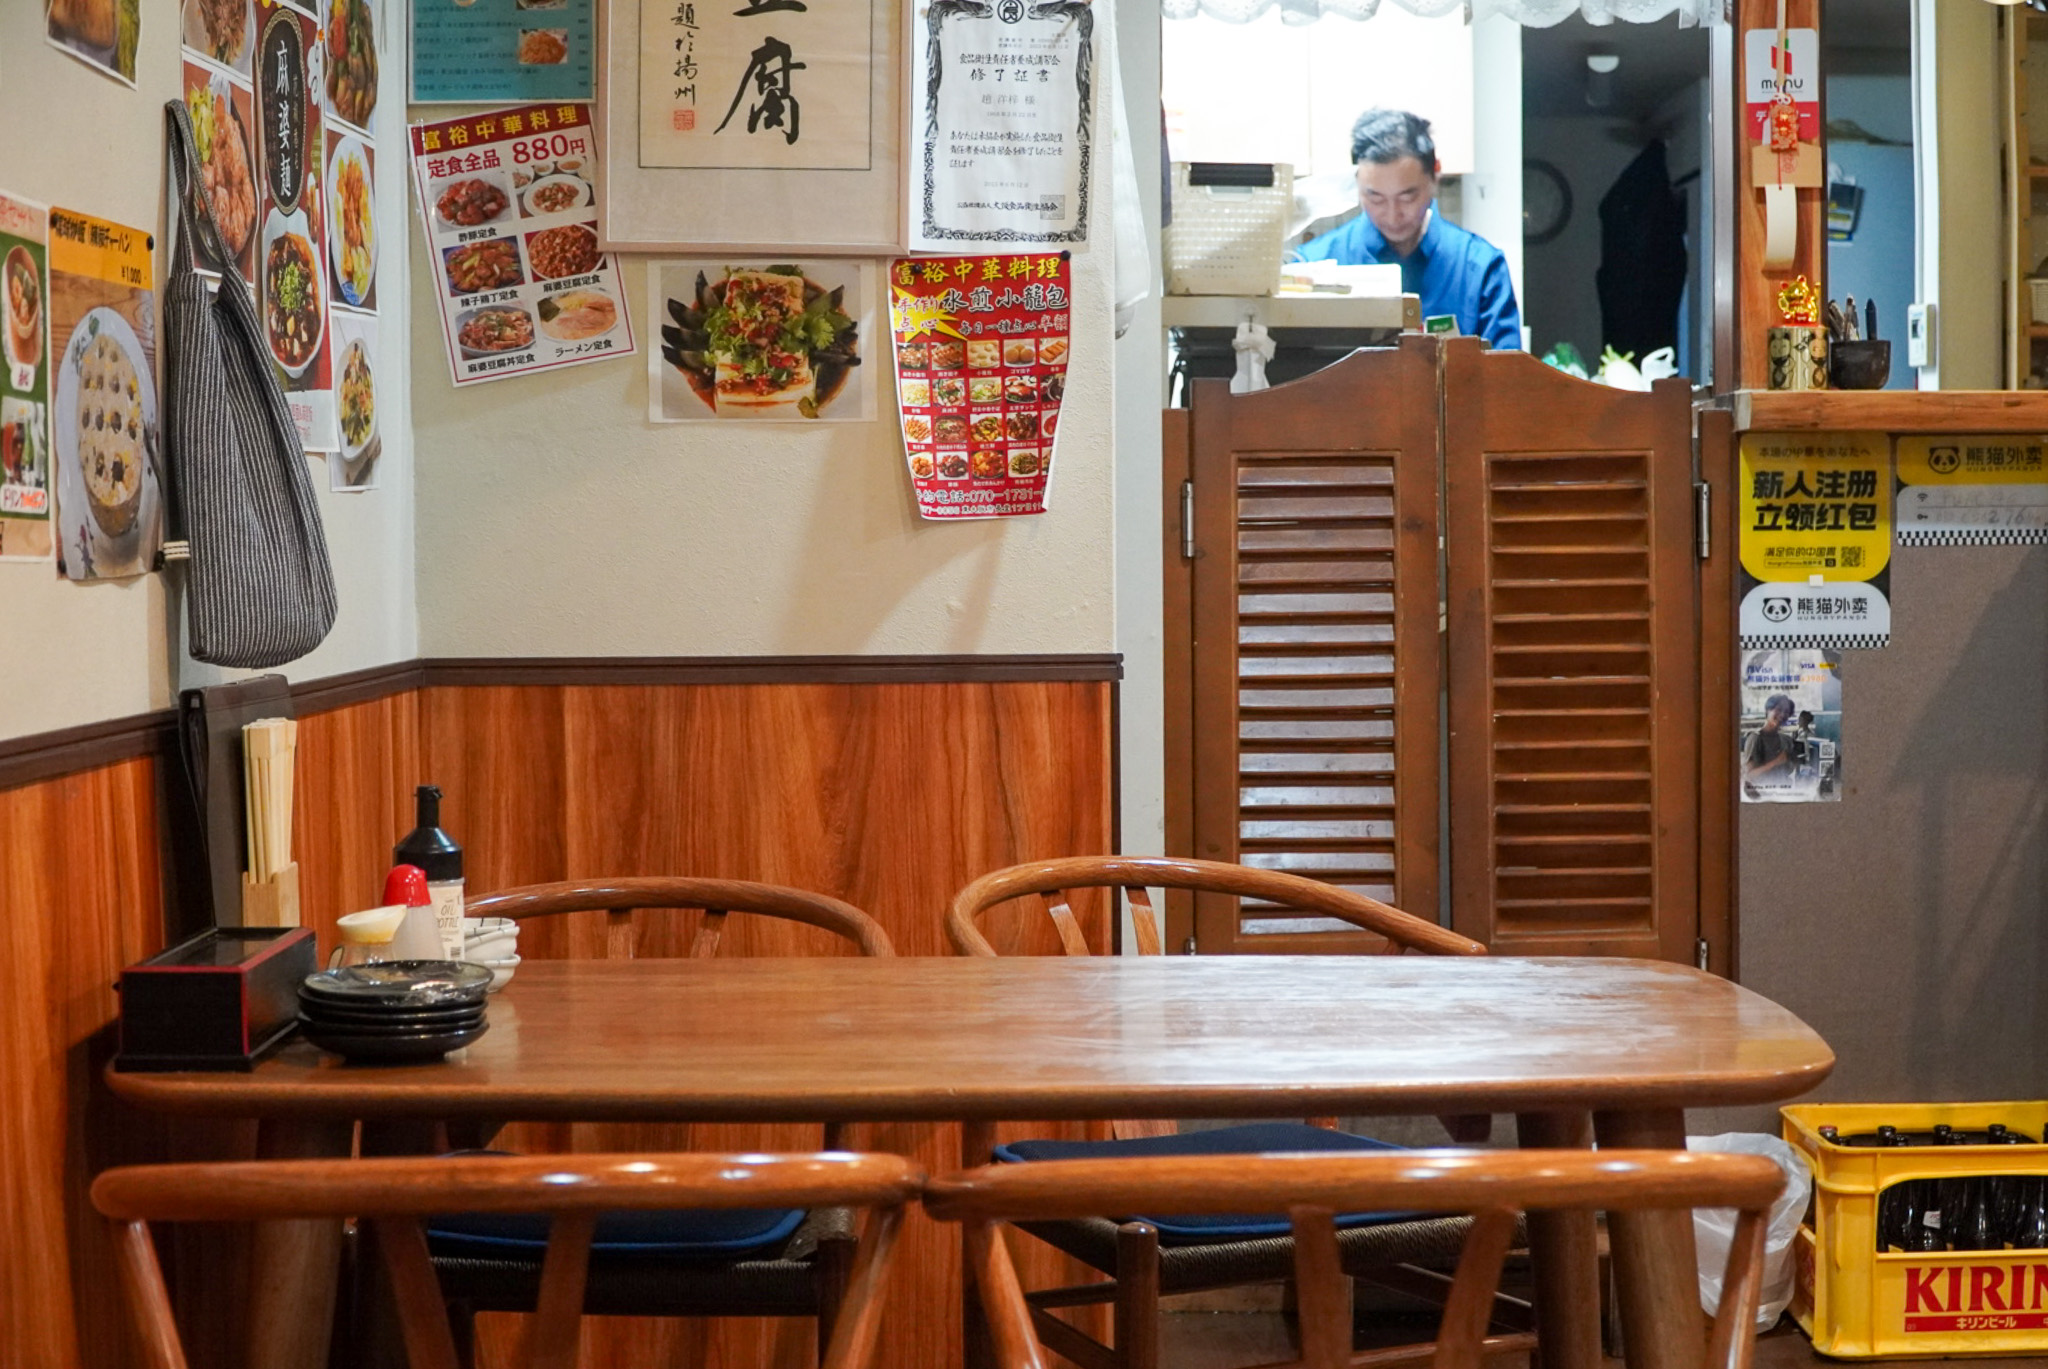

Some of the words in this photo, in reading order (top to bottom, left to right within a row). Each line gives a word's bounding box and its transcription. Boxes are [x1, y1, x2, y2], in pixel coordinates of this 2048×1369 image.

[713, 0, 808, 145] 腐
[427, 149, 501, 179] 定食全品
[512, 134, 586, 164] 880円
[543, 274, 601, 293] 麻婆豆腐定食
[896, 256, 1061, 285] 富裕中華料理
[943, 283, 1068, 314] 水煎小籠包
[555, 339, 613, 357] ラーメン定食
[1966, 446, 2043, 466] 熊猫外卖
[1752, 470, 1877, 499] 新人注册
[1752, 503, 1877, 531] 立领红包
[1797, 597, 1868, 614] 熊猫外卖
[1956, 1316, 2017, 1330] キリンビール
